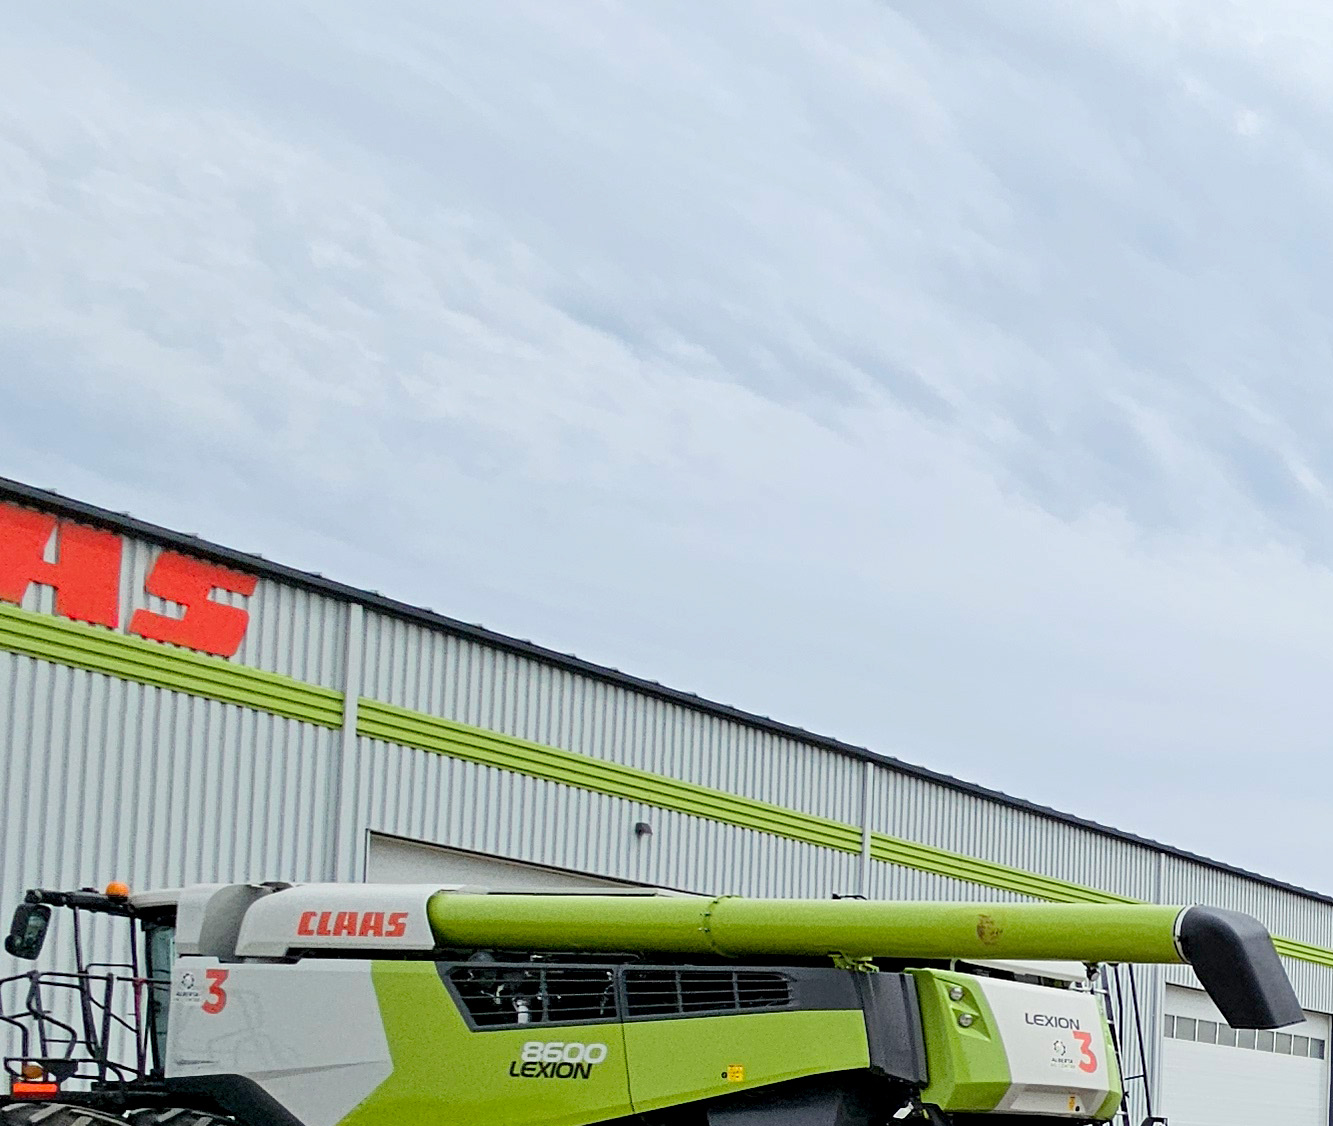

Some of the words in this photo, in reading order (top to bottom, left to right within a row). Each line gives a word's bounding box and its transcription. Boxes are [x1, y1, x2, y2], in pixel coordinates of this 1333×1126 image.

[297, 911, 409, 937] CLAAS
[201, 968, 230, 1014] 3
[1025, 1012, 1080, 1030] LEXION
[521, 1041, 608, 1064] 8600
[1072, 1030, 1097, 1073] 3
[509, 1060, 593, 1079] LEXION
